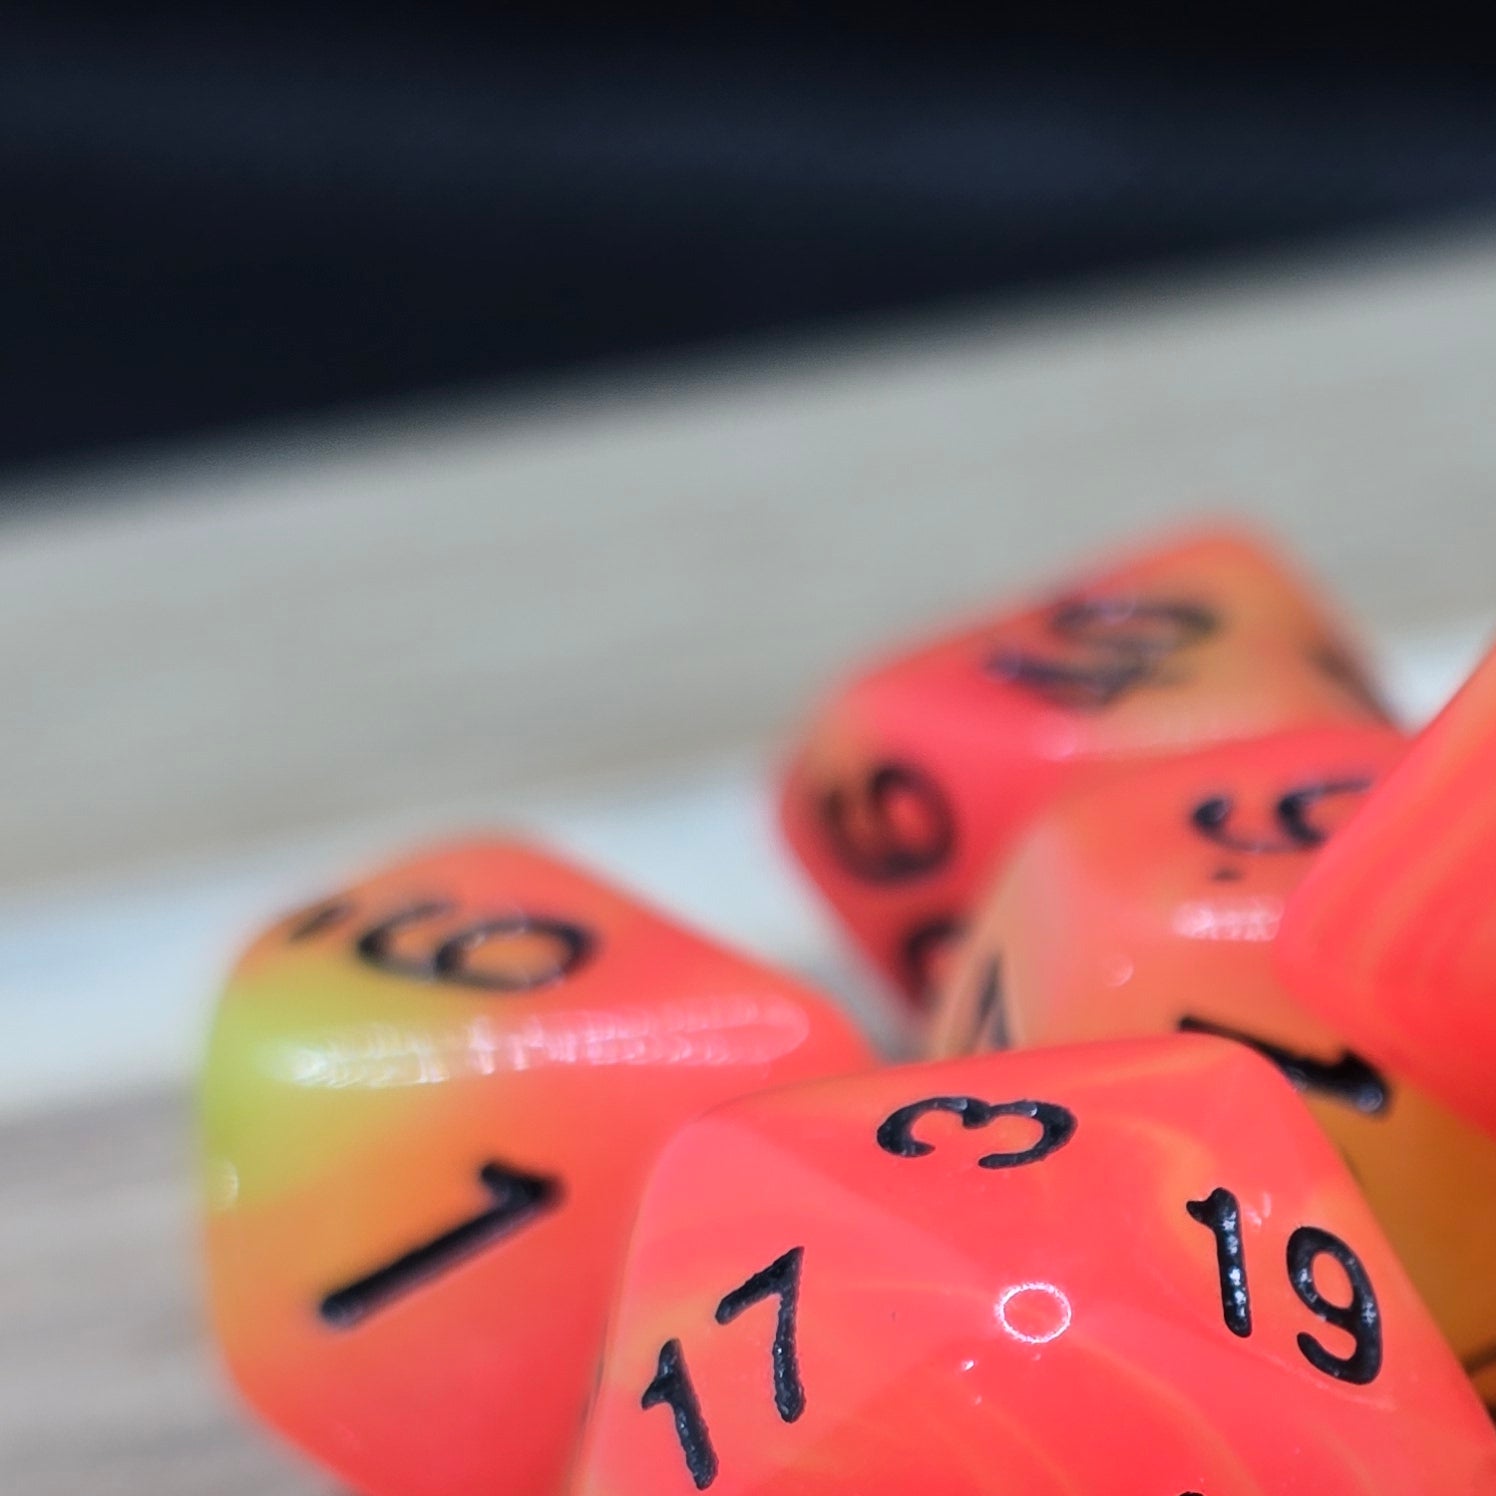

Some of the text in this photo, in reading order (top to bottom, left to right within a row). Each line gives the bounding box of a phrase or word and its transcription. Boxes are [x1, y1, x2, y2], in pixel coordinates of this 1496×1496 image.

[875, 1095, 1077, 1170] 3
[320, 1160, 568, 1330] 1
[1186, 1187, 1383, 1385] 19
[641, 1245, 806, 1490] 17
